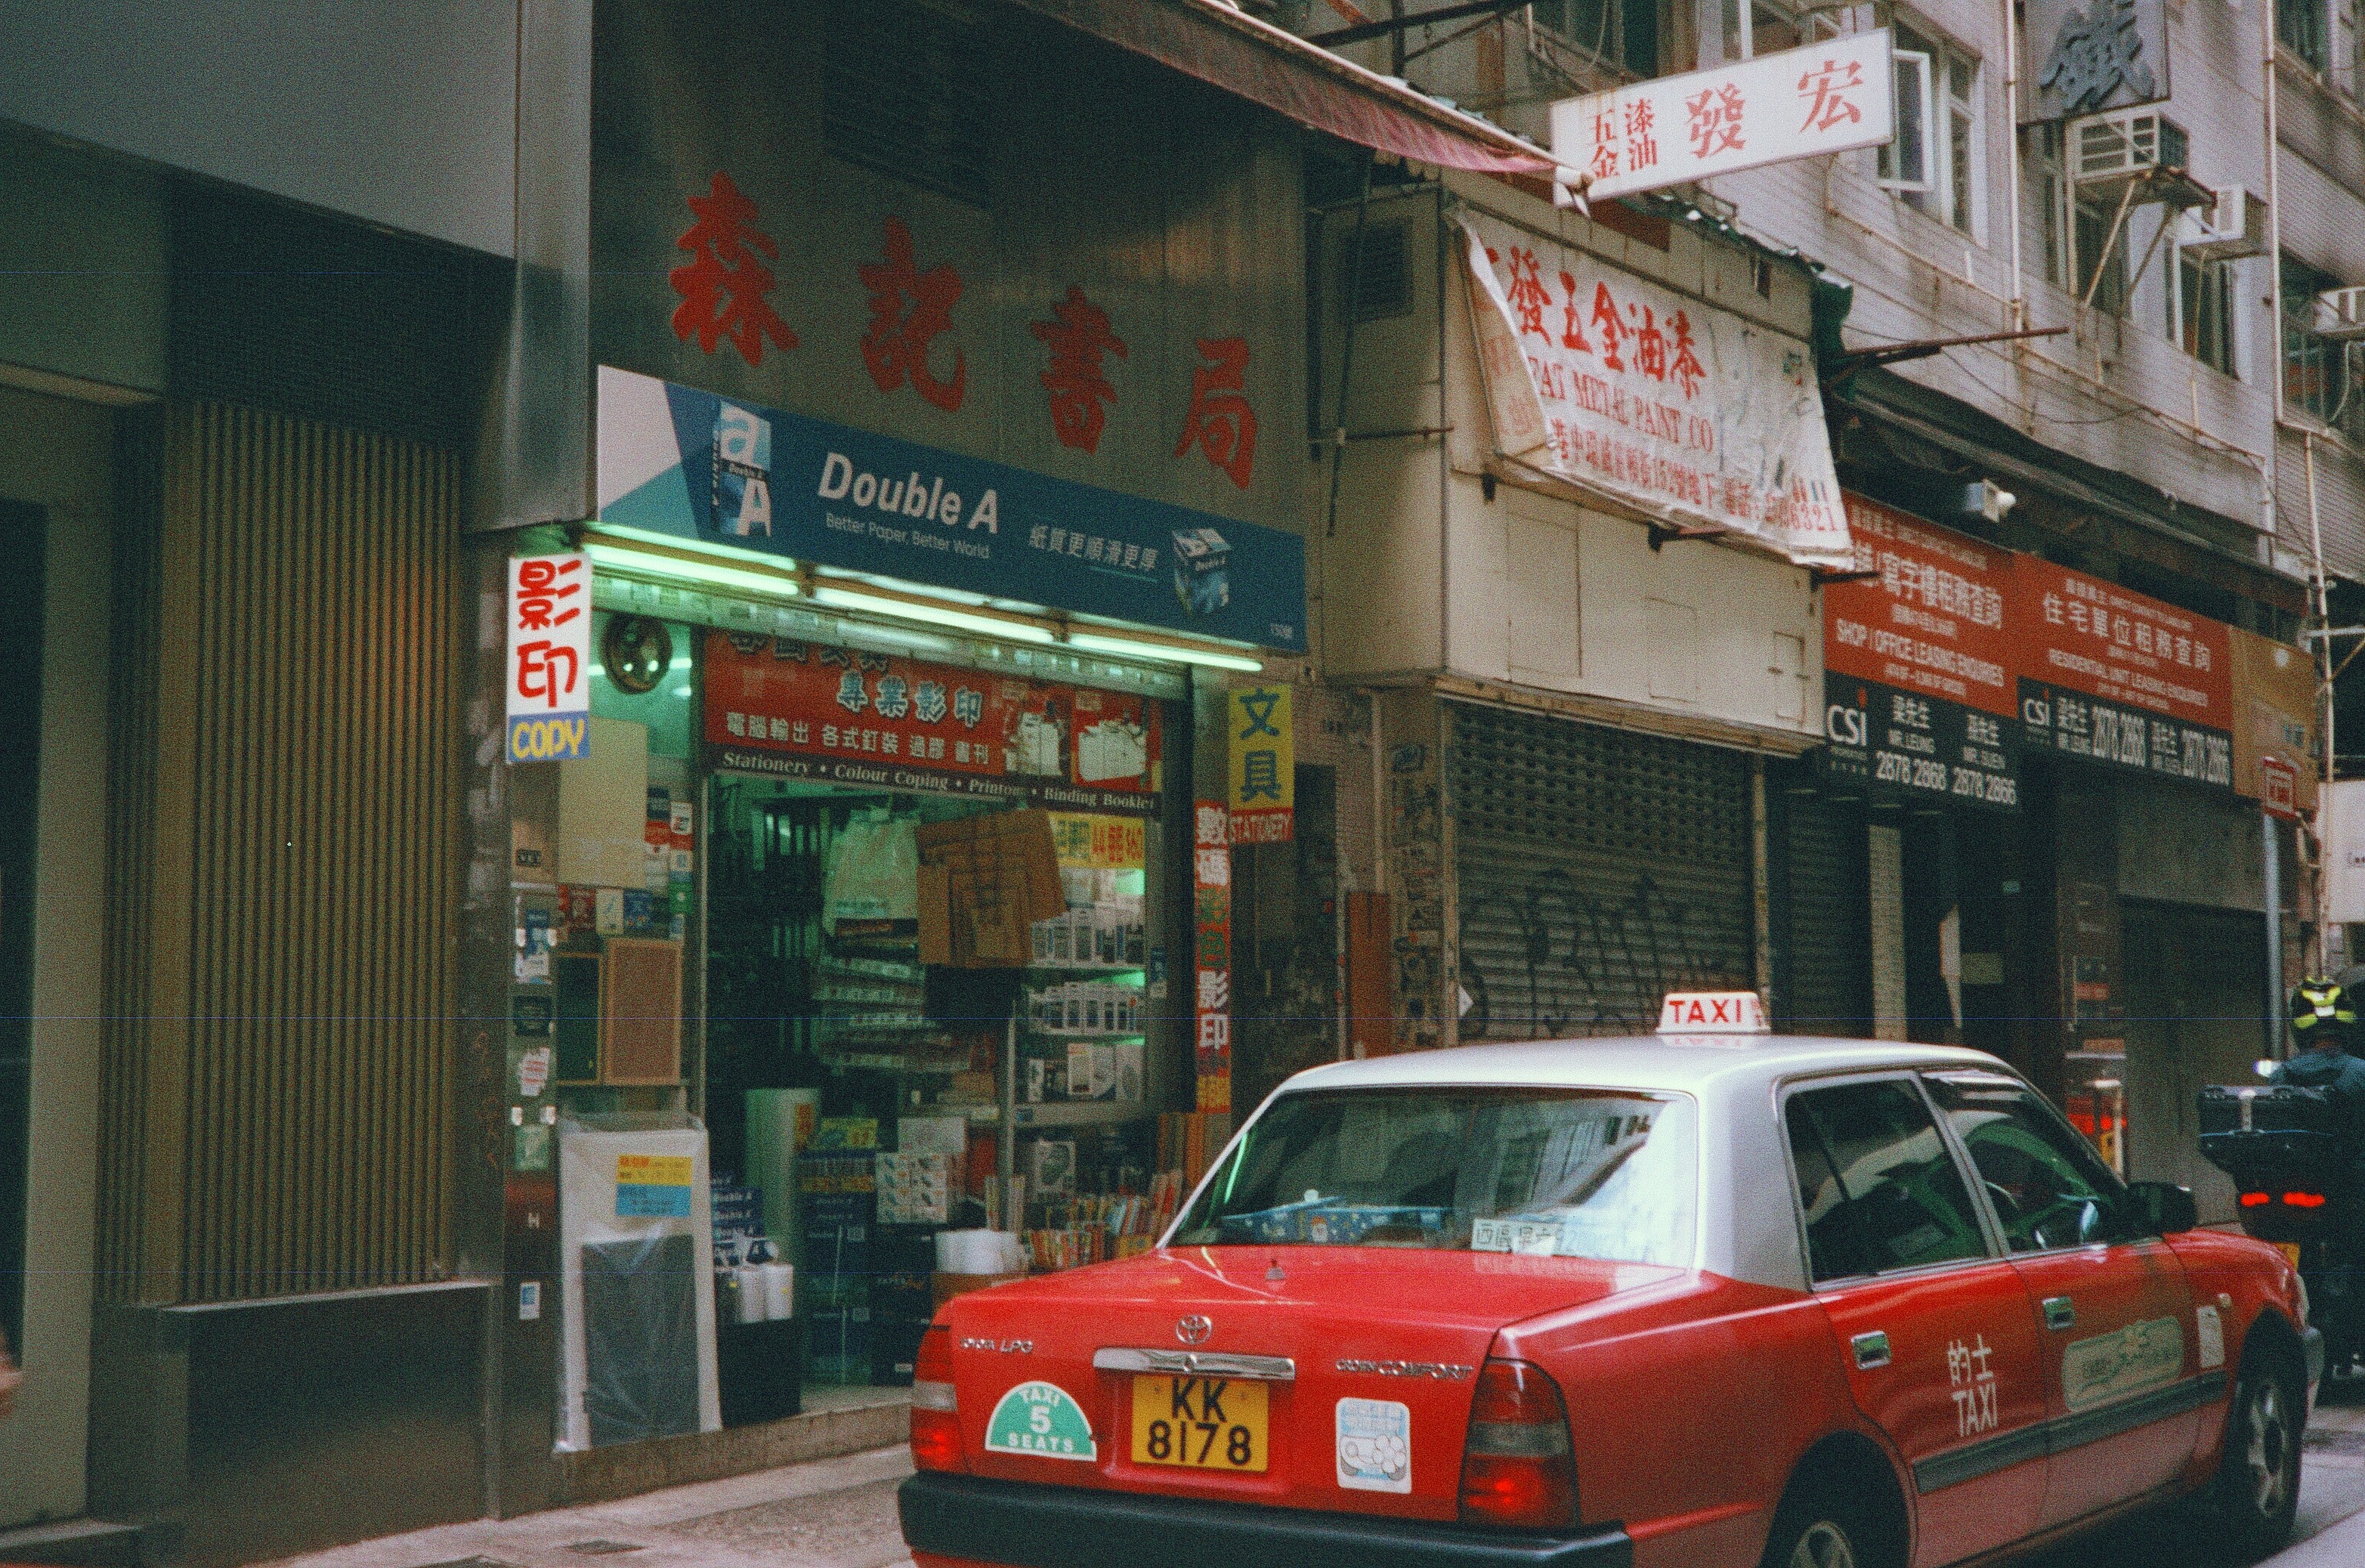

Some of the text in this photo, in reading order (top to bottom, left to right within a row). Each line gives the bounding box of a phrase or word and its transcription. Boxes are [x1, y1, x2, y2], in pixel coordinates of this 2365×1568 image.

[669, 170, 1259, 490] 森記書局
[1486, 246, 1706, 401] 發五金油漆
[818, 451, 998, 534] Double A
[826, 512, 864, 534] Better
[912, 530, 950, 552] Better
[954, 540, 990, 559] World
[517, 560, 582, 708] 影印
[2042, 590, 2212, 673] 住宅單位租務查詢
[836, 669, 982, 728] 專業影印
[512, 719, 585, 759] COPY
[1238, 687, 1282, 801] 文具
[722, 750, 810, 776] Stationery
[834, 762, 888, 783] Colour
[894, 769, 949, 792] Coping
[1044, 786, 1098, 808] Binding
[1668, 999, 1742, 1024] TAXI
[1948, 1333, 1993, 1387] 的士
[1019, 1387, 1061, 1408] TAXI
[1030, 1405, 1052, 1434] 5
[1172, 1378, 1228, 1422] KK
[1952, 1381, 1999, 1437] TAXI
[1007, 1432, 1074, 1453] SEATS
[1147, 1419, 1253, 1466] 8178
